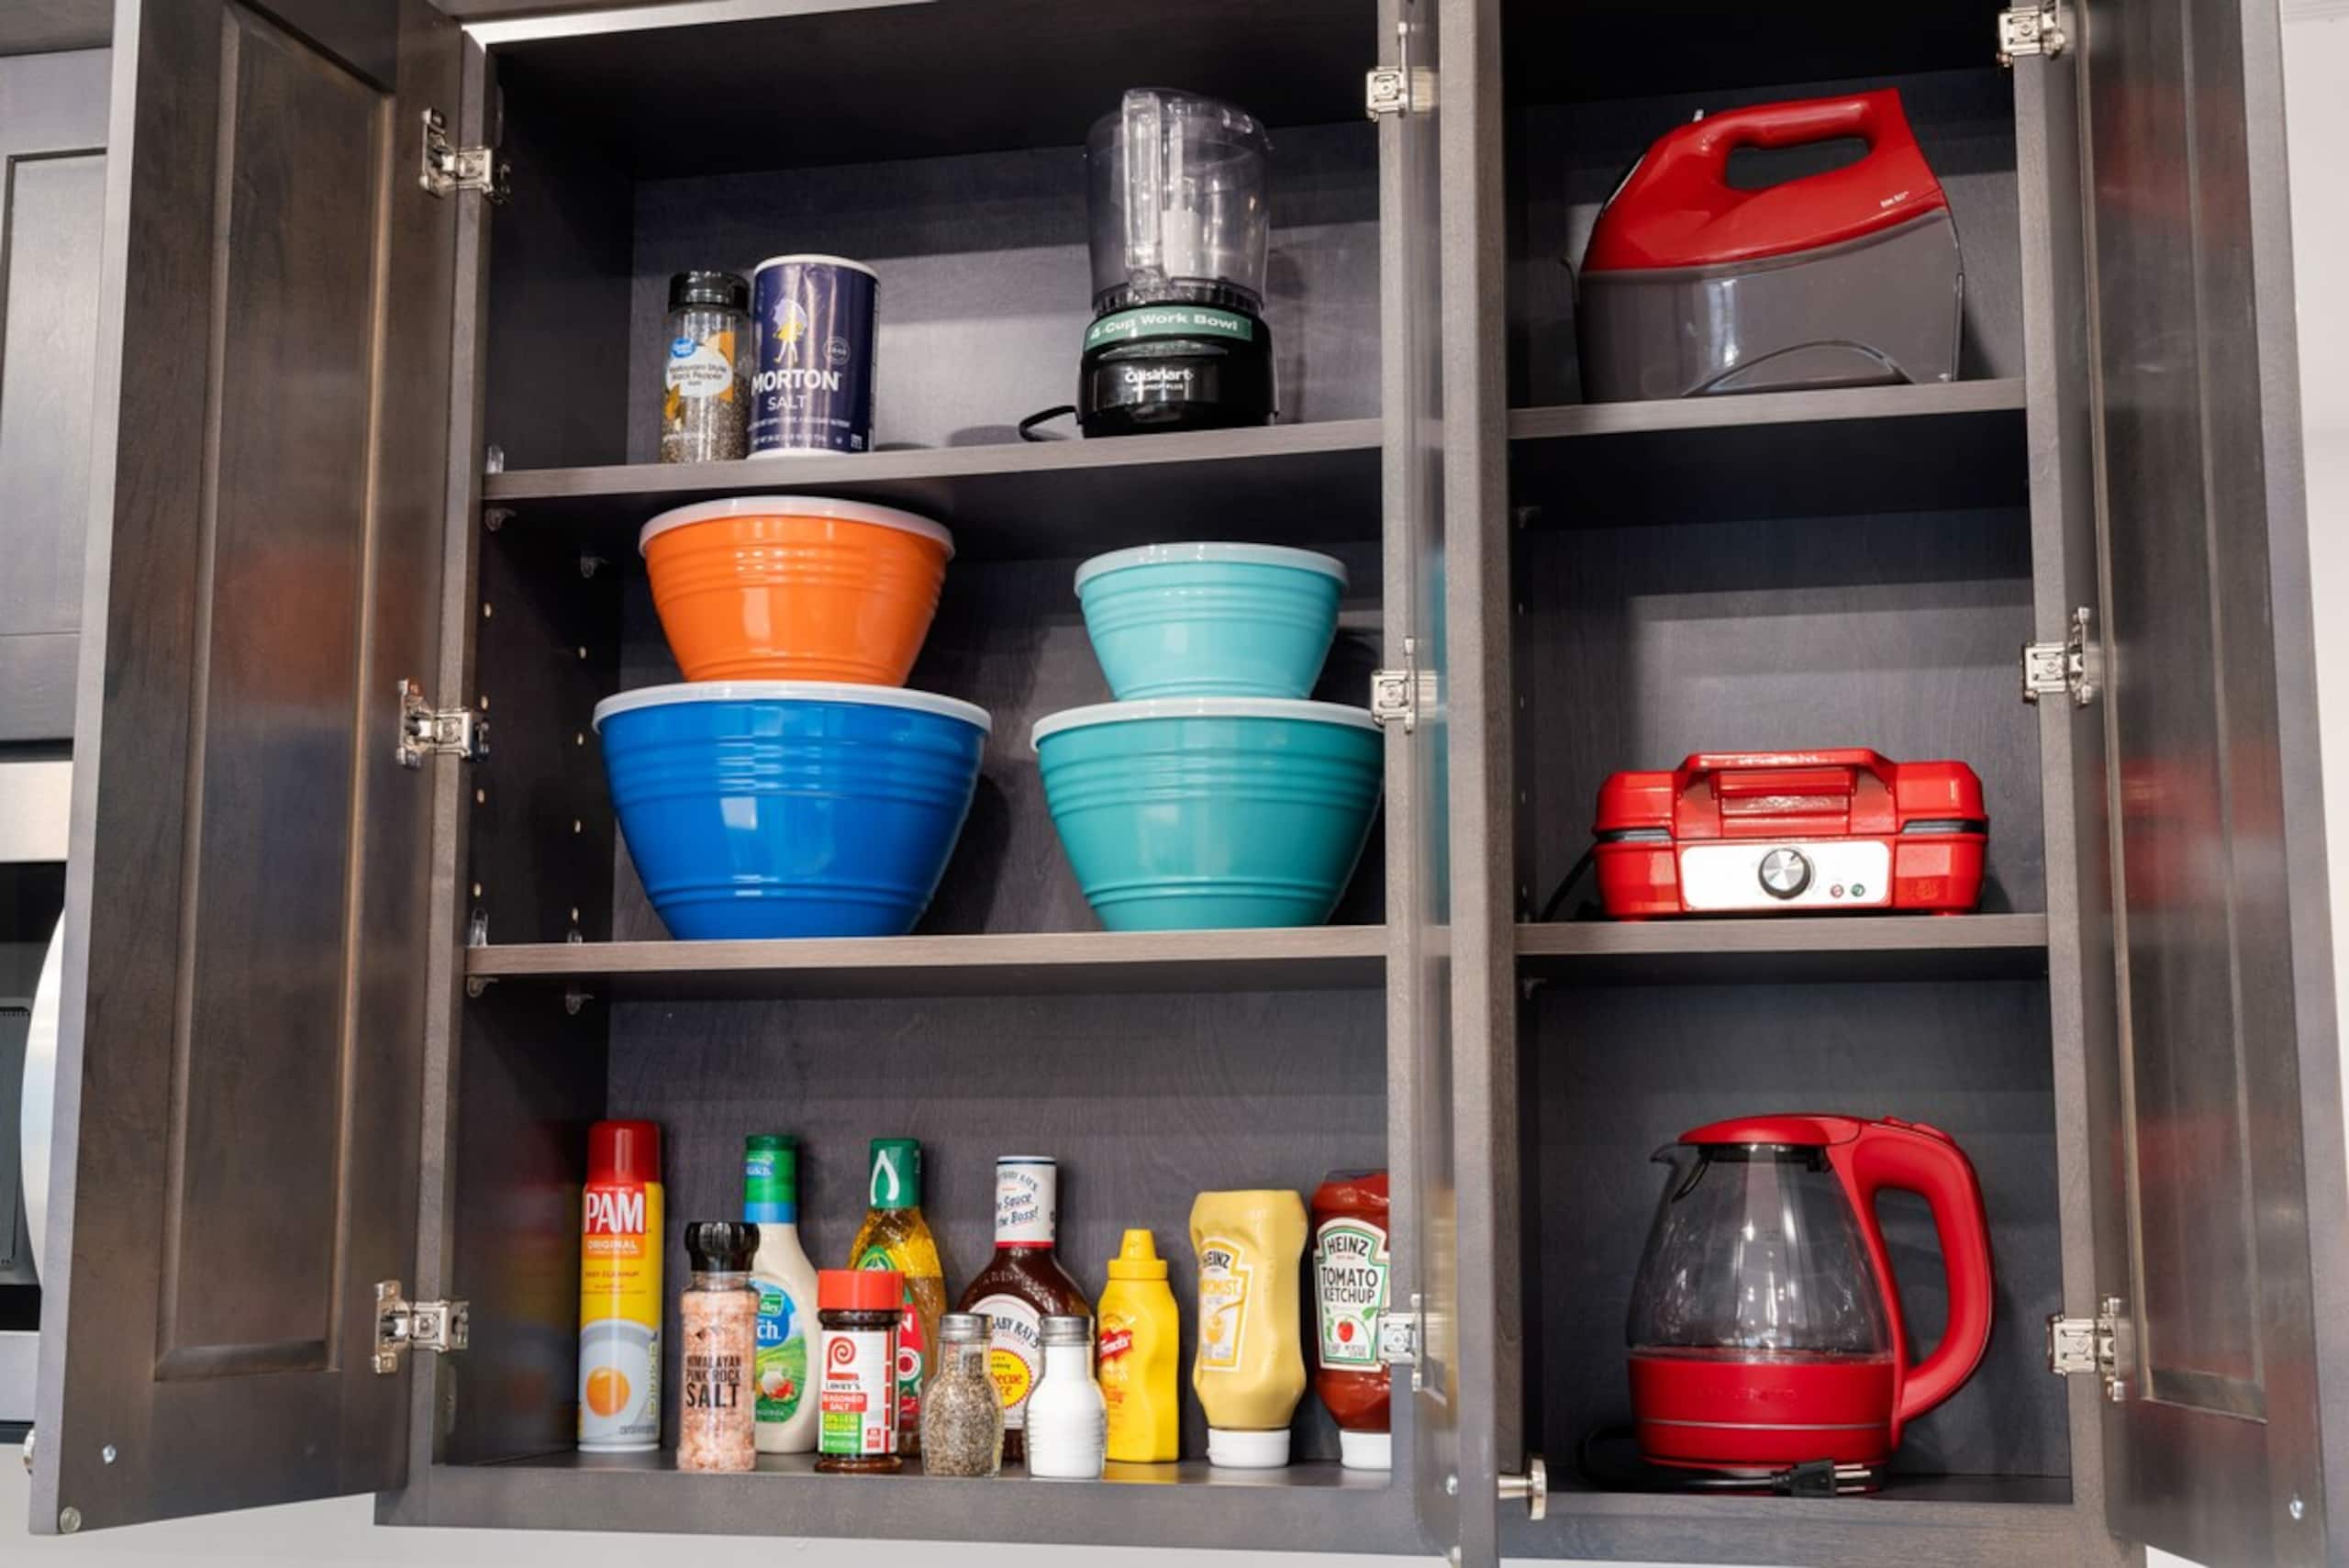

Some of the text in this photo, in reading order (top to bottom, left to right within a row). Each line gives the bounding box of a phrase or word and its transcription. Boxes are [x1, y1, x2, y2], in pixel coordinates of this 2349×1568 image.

[1140, 312, 1187, 326] Work
[1194, 314, 1239, 331] Bowl
[751, 369, 839, 396] MORTON
[1124, 368, 1189, 384] Cuisinart
[767, 395, 807, 411] SALT
[583, 1191, 644, 1235] PAM
[586, 1239, 639, 1251] ORIGINAL
[1326, 1235, 1369, 1258] HEINZ
[1321, 1266, 1379, 1288] TOMATO
[1324, 1286, 1375, 1305] KETCHUP
[991, 1316, 1013, 1330] ABY
[686, 1354, 740, 1367] HIMALAYAN
[686, 1368, 740, 1383] PINK ROCK
[686, 1382, 740, 1408] SALT
[829, 1402, 850, 1411] SALT
